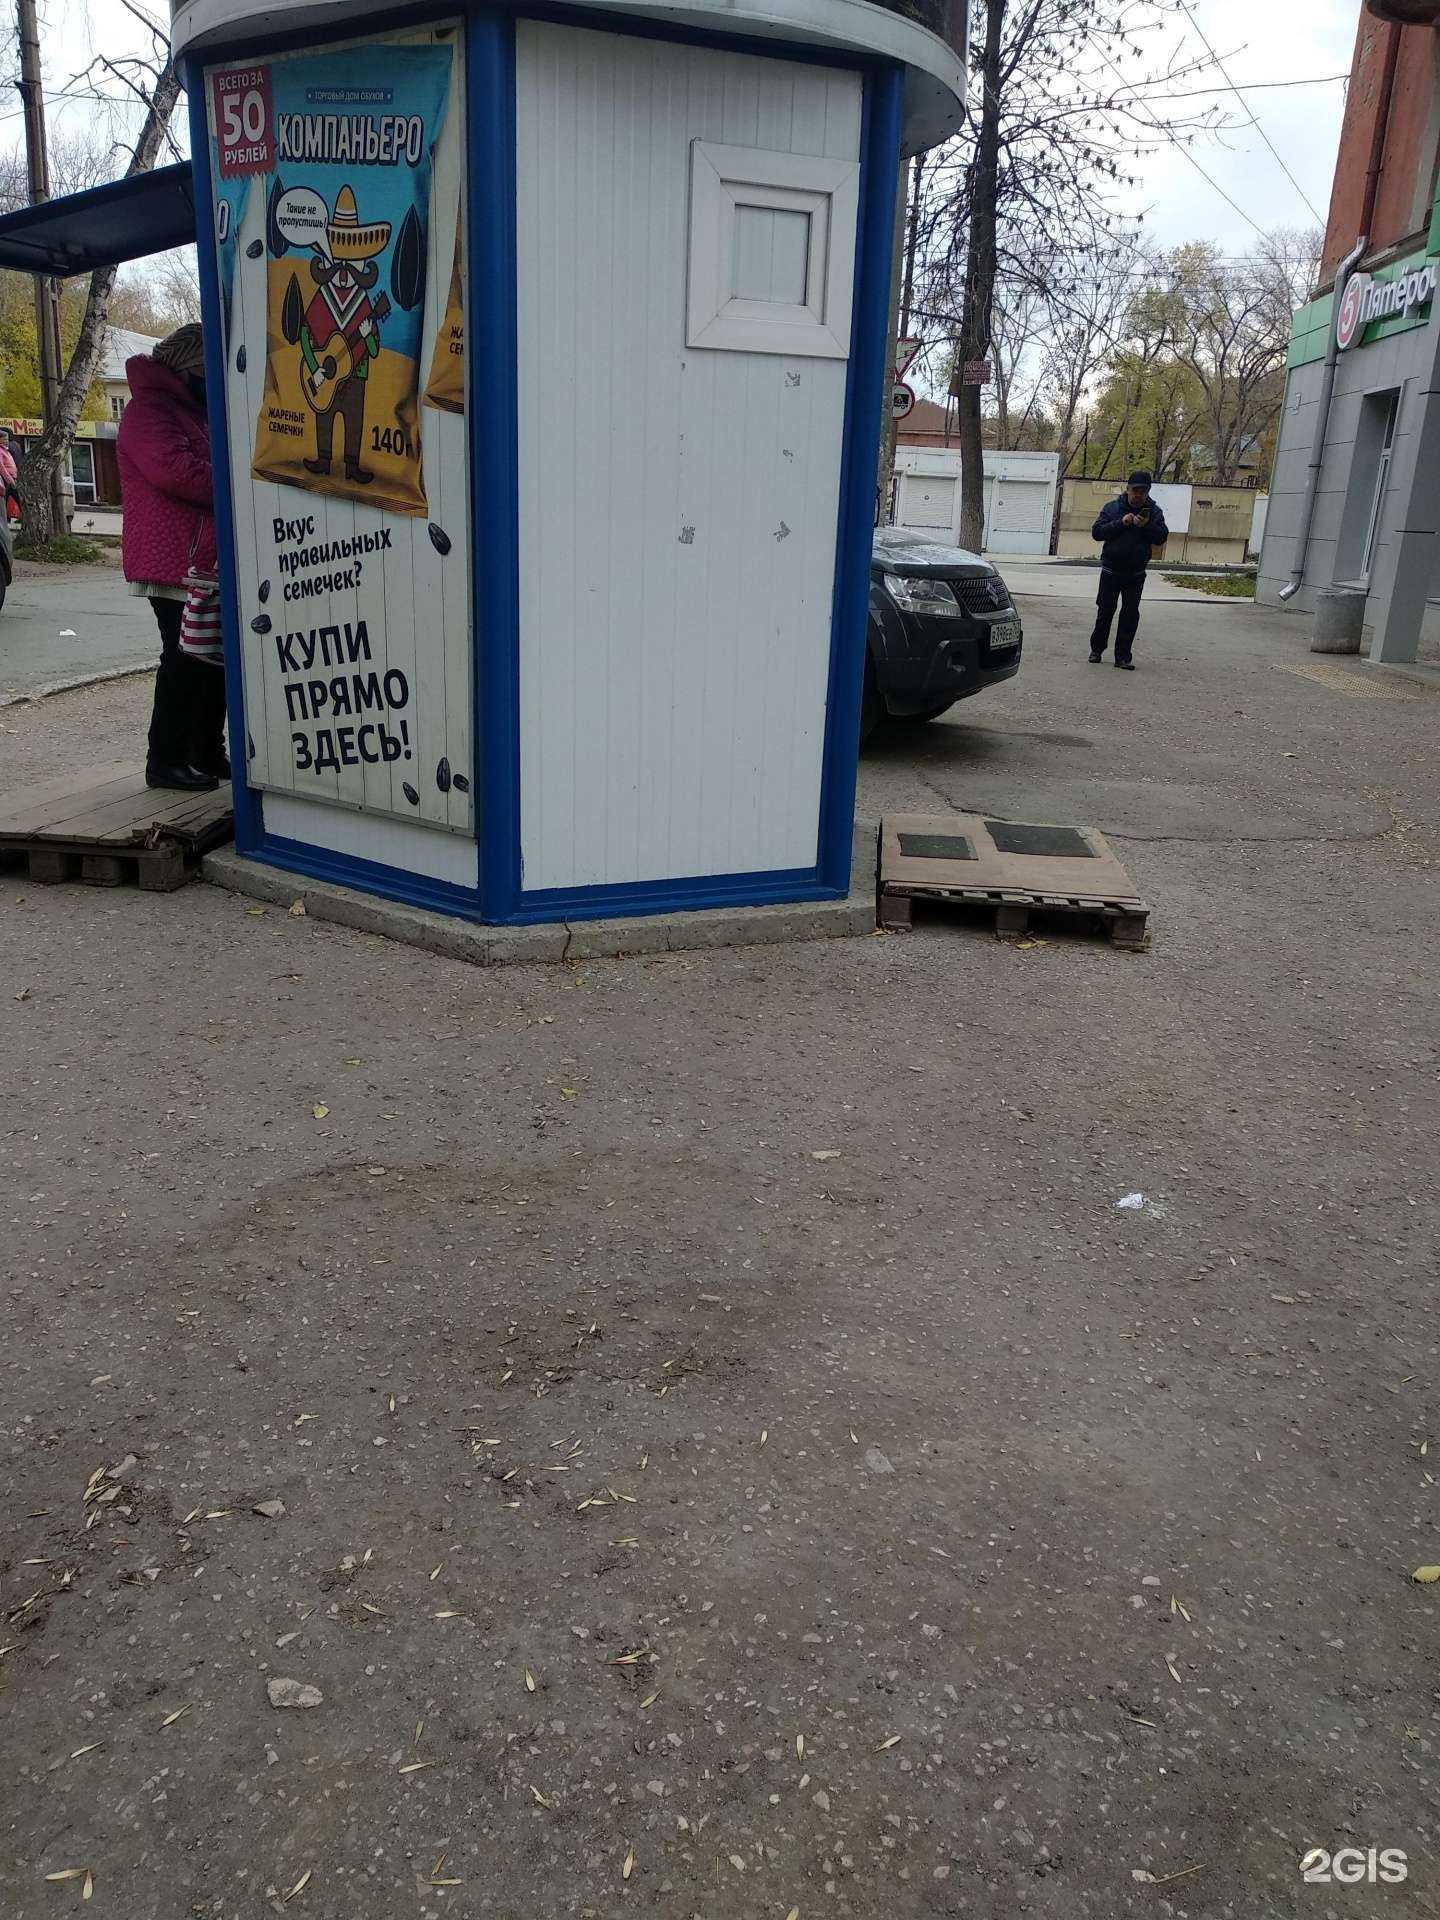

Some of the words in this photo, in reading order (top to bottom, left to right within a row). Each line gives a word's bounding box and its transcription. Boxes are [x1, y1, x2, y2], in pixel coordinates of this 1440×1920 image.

[219, 73, 249, 91] ВСЕГО
[250, 70, 264, 85] ЗА
[222, 89, 266, 146] 50
[224, 142, 268, 166] РУБЛЕЙ
[278, 114, 423, 167] КОМПАНЬЕРО
[278, 216, 327, 229] пропустишь!
[287, 202, 306, 214] Такие
[307, 206, 317, 215] не
[268, 407, 305, 424] ЖАРЕНЫЕ
[268, 421, 304, 437] СЕМЕЧКИ
[273, 515, 315, 545] Вкус
[278, 528, 393, 577] правильных
[283, 560, 363, 602] семечек?
[275, 620, 372, 673] КУПИ
[284, 668, 409, 721] ПРЯМО
[291, 720, 412, 775] ЗДЕСЬ!
